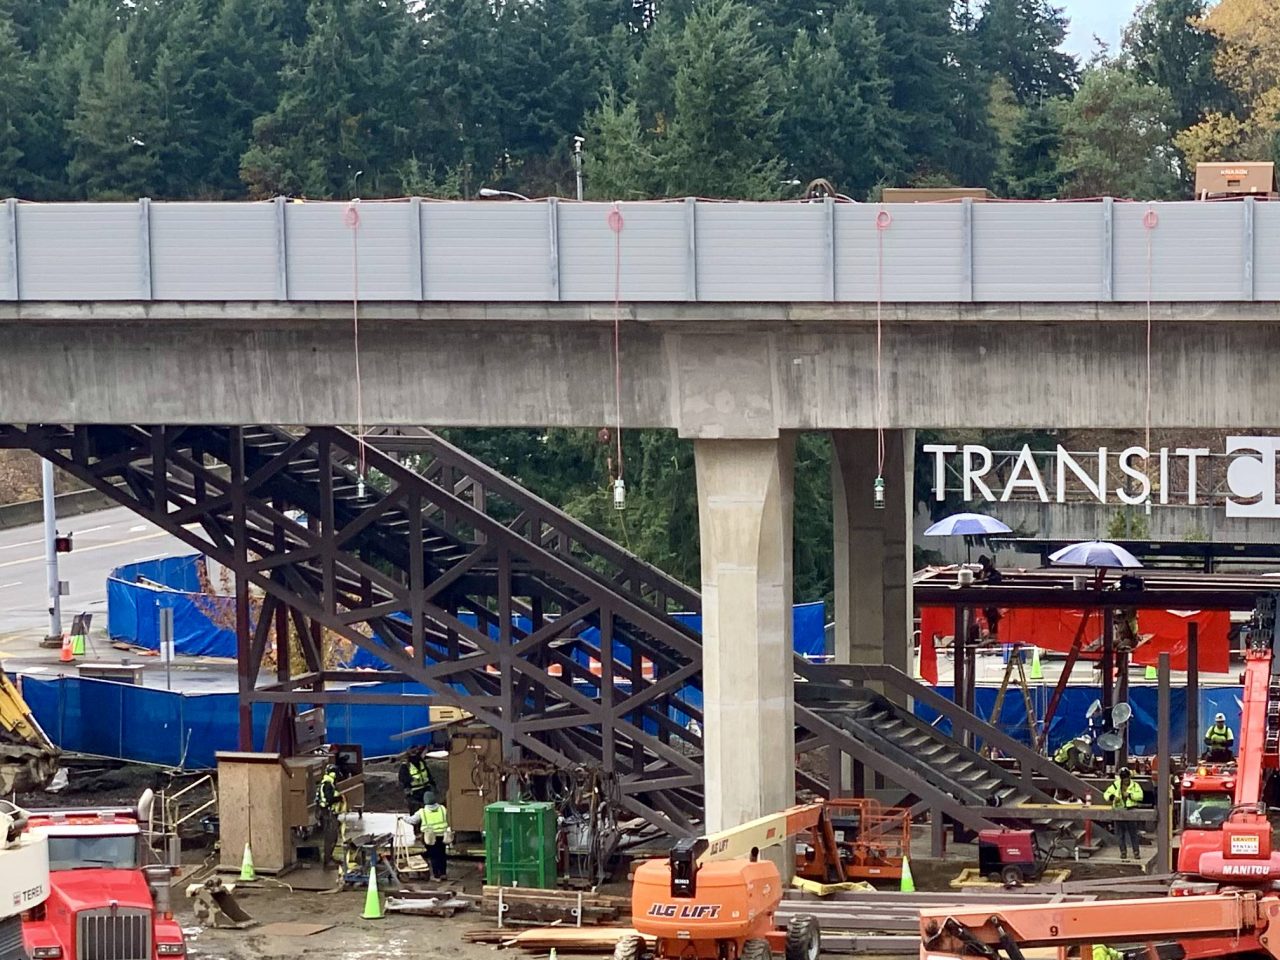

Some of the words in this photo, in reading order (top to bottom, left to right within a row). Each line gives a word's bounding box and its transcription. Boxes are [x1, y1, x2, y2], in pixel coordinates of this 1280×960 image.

[923, 443, 1210, 505] TRANSIT
[1222, 865, 1270, 875] MANITOU
[647, 904, 676, 917] JLG
[680, 904, 721, 918] LIFT
[1050, 925, 1059, 937] 9
